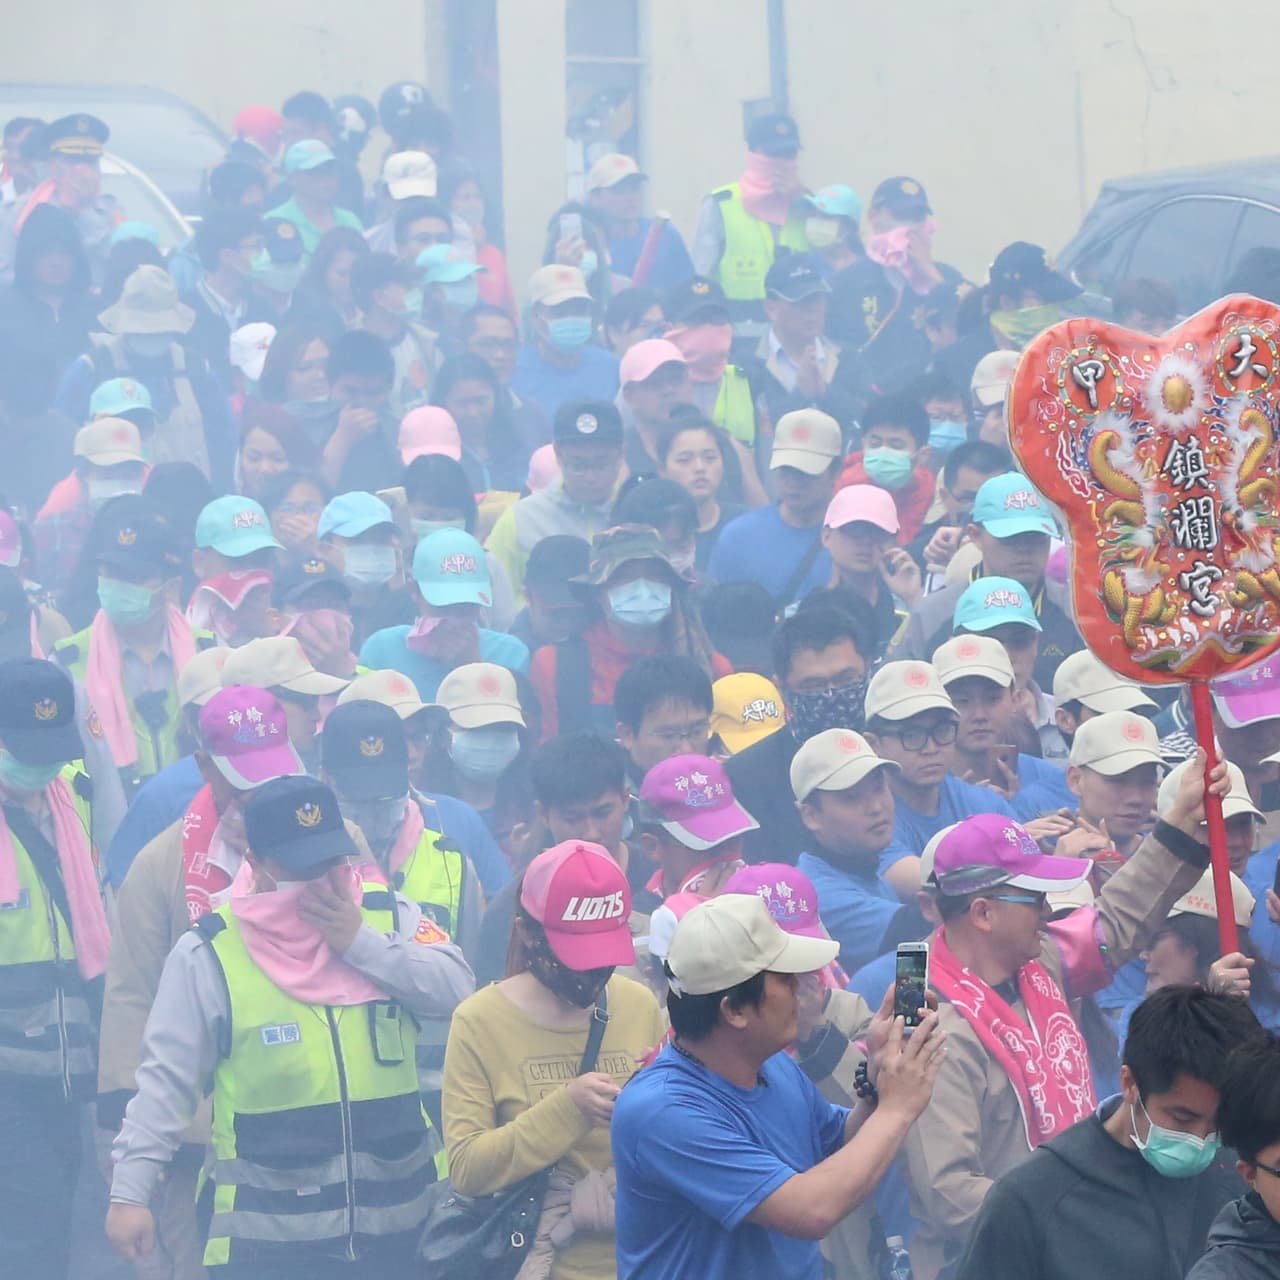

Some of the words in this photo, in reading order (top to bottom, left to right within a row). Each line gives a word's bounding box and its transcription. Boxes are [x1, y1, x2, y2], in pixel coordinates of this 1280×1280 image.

[1231, 333, 1270, 380] 大
[1070, 360, 1107, 406] 甲
[1163, 437, 1223, 618] 鎮瀾宮
[742, 698, 781, 724] 大甲媽
